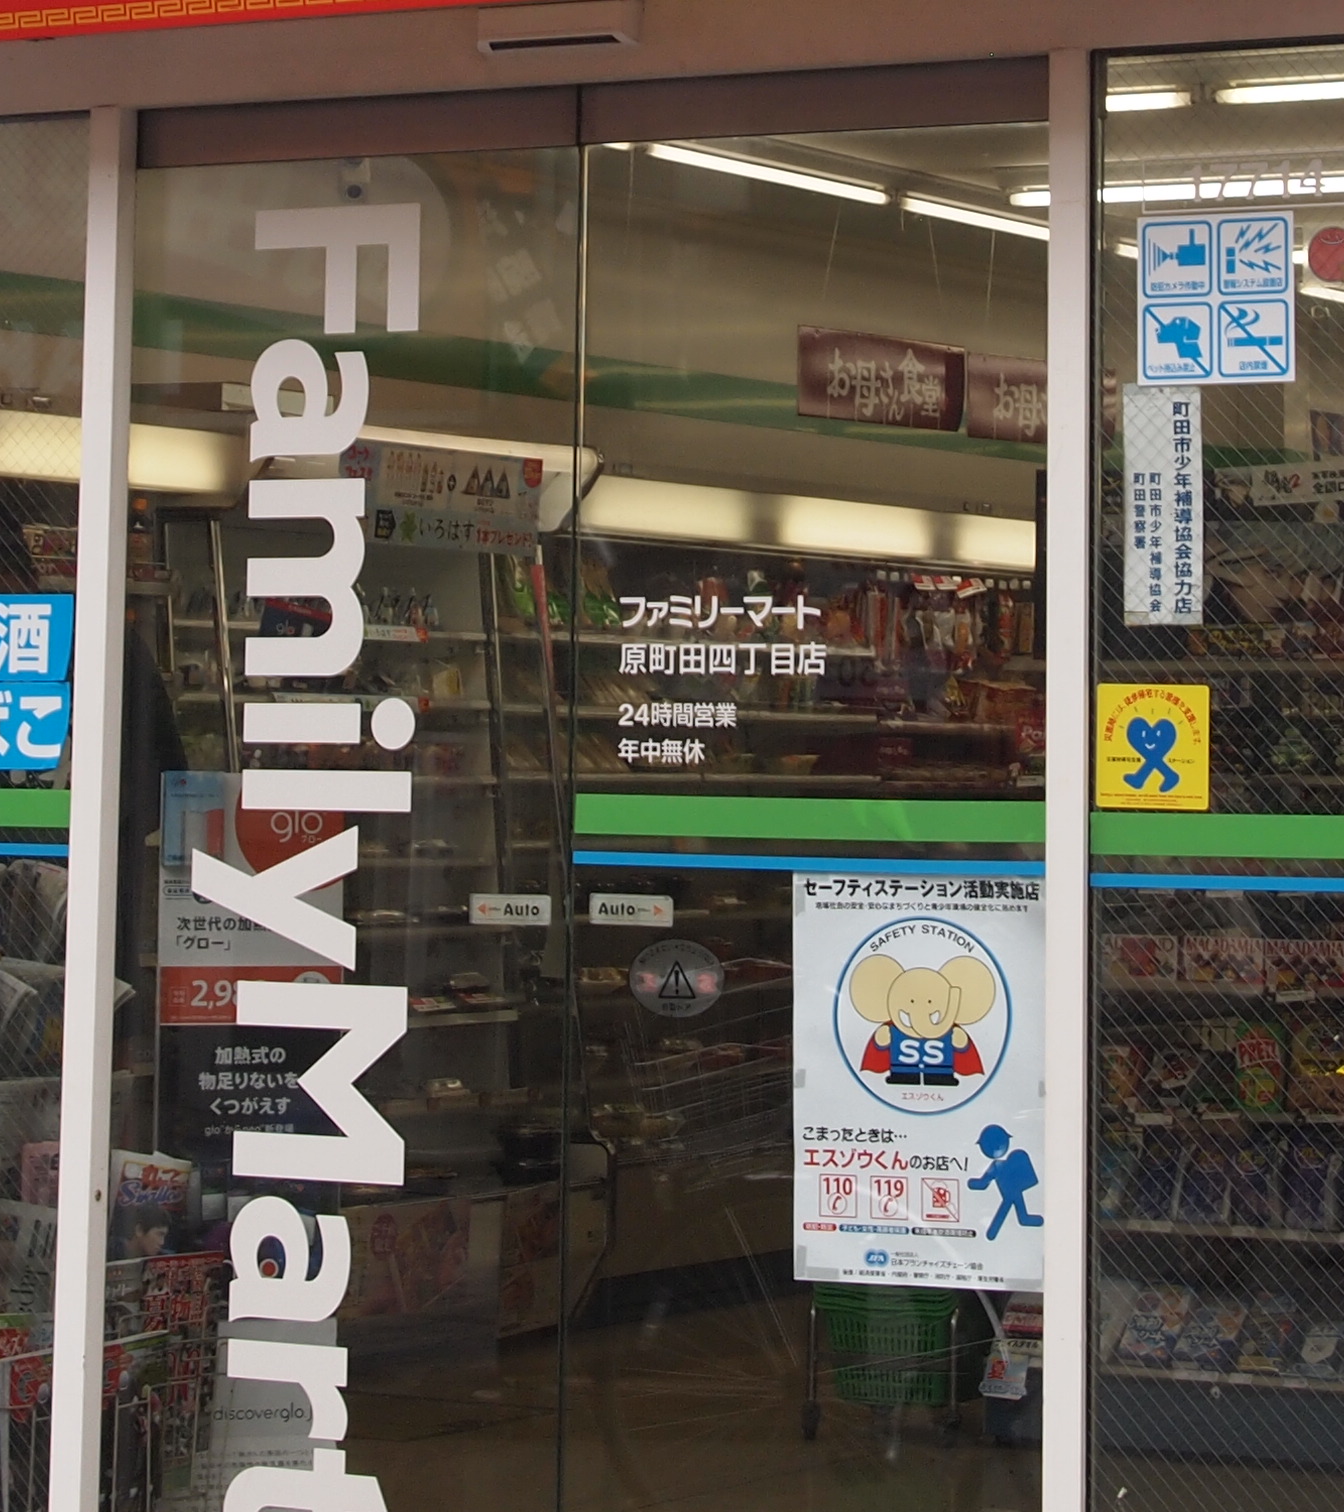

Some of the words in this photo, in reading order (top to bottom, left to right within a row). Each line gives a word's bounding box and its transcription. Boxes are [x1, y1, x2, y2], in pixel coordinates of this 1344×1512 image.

[827, 347, 943, 421] お母さん食堂
[993, 372, 1047, 437] お母
[1172, 400, 1194, 615] 町田市少年補導協会協力店
[619, 595, 822, 630] ファミリーマート
[618, 642, 827, 676] 原町田四丁目店
[617, 702, 737, 728] 24時間営業
[617, 738, 705, 764] 年中無休
[270, 810, 323, 843] glo
[803, 878, 1041, 901] セーフティステーション活動実施店
[503, 902, 540, 916] Auto
[598, 901, 636, 916] Auto
[175, 935, 232, 951] 「グロー」
[869, 924, 917, 953] SAFETY
[921, 924, 976, 954] STATION
[214, 1046, 286, 1065] 加熱式の
[898, 1039, 945, 1064] SS
[198, 1071, 300, 1090] 物足りないを
[209, 1097, 292, 1115] くつがえす
[803, 1148, 969, 1172] エスゾウくんのお店へ!
[822, 1177, 853, 1196] 110
[874, 1178, 905, 1197] 119
